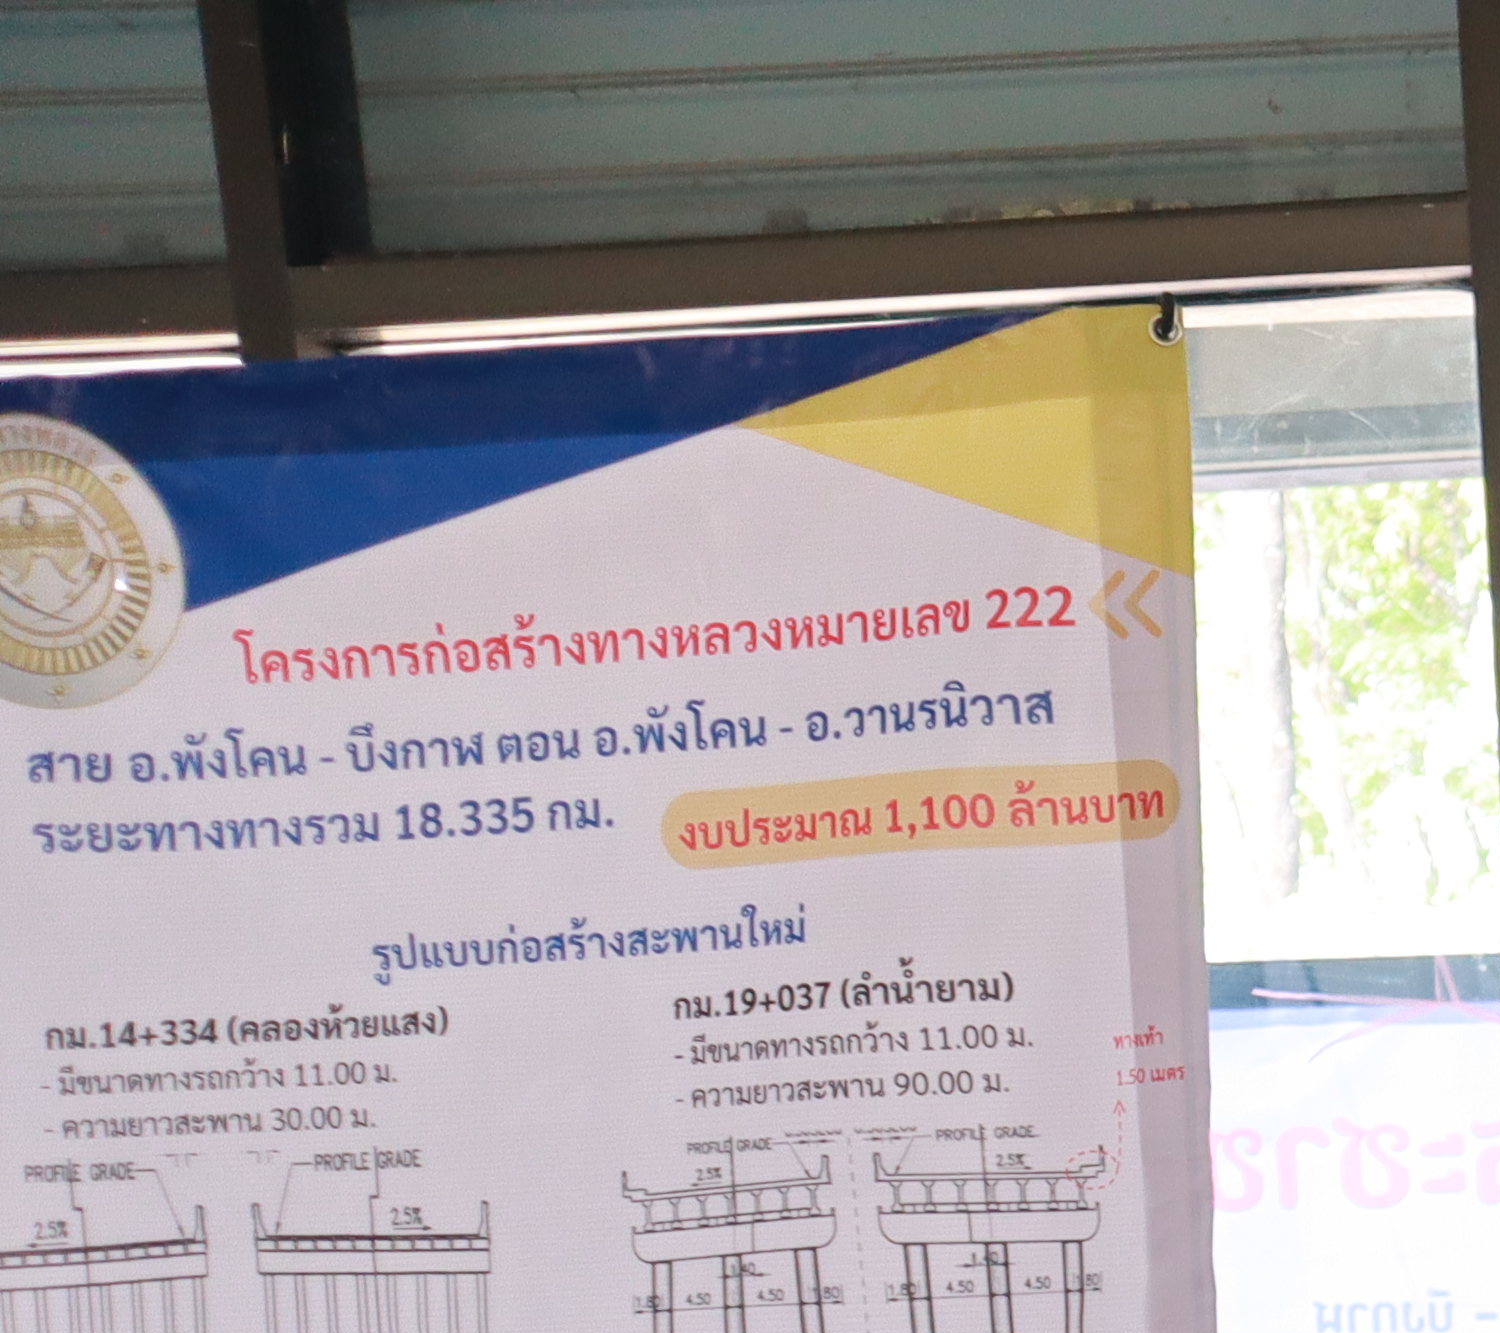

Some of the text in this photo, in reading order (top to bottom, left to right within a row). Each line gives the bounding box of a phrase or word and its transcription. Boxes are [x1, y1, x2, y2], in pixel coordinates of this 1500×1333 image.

[234, 586, 1076, 684] โครงการก่อสร้างทางหลวงหมายเลข 222
[26, 749, 111, 783] สาย
[129, 729, 306, 784] อ.พังโคน
[347, 722, 484, 772] บึงกาฬ
[500, 726, 580, 764] ตอน
[597, 701, 768, 757] อ.พังโคน
[806, 680, 1055, 741] อ.วานรนิวาส
[32, 797, 614, 854] ระยะทางทางรวม 18.335 กม.
[679, 779, 1165, 850] งบประมาณ 1,100 ล้านบาท
[372, 903, 807, 986] รูปแบบก่อสร้างสะพานใหม่
[673, 956, 1014, 1020] กม.19+037 (ลำน้ำยาม)
[45, 1003, 449, 1050] กม.14+334 (คลองห้วยแสง)
[689, 1021, 909, 1064] มีขนาดทางรถกว้าง
[920, 1024, 998, 1051] 11.00
[1006, 1026, 1033, 1049] ม.
[58, 1058, 285, 1096] มีขนาดทางรถกว้าง
[294, 1061, 367, 1087] 11.00
[374, 1063, 398, 1085] ม.
[691, 1078, 886, 1109] ความยาวสะพาน
[893, 1070, 974, 1096] 90.00
[983, 1071, 1009, 1093] ม.
[62, 1113, 262, 1139] ความยาวสะพาน
[270, 1107, 343, 1133] 30.00
[350, 1108, 376, 1130] ม.
[24, 1162, 135, 1182] PROFILE GRADE
[313, 1150, 422, 1172] PROFILE GRADE
